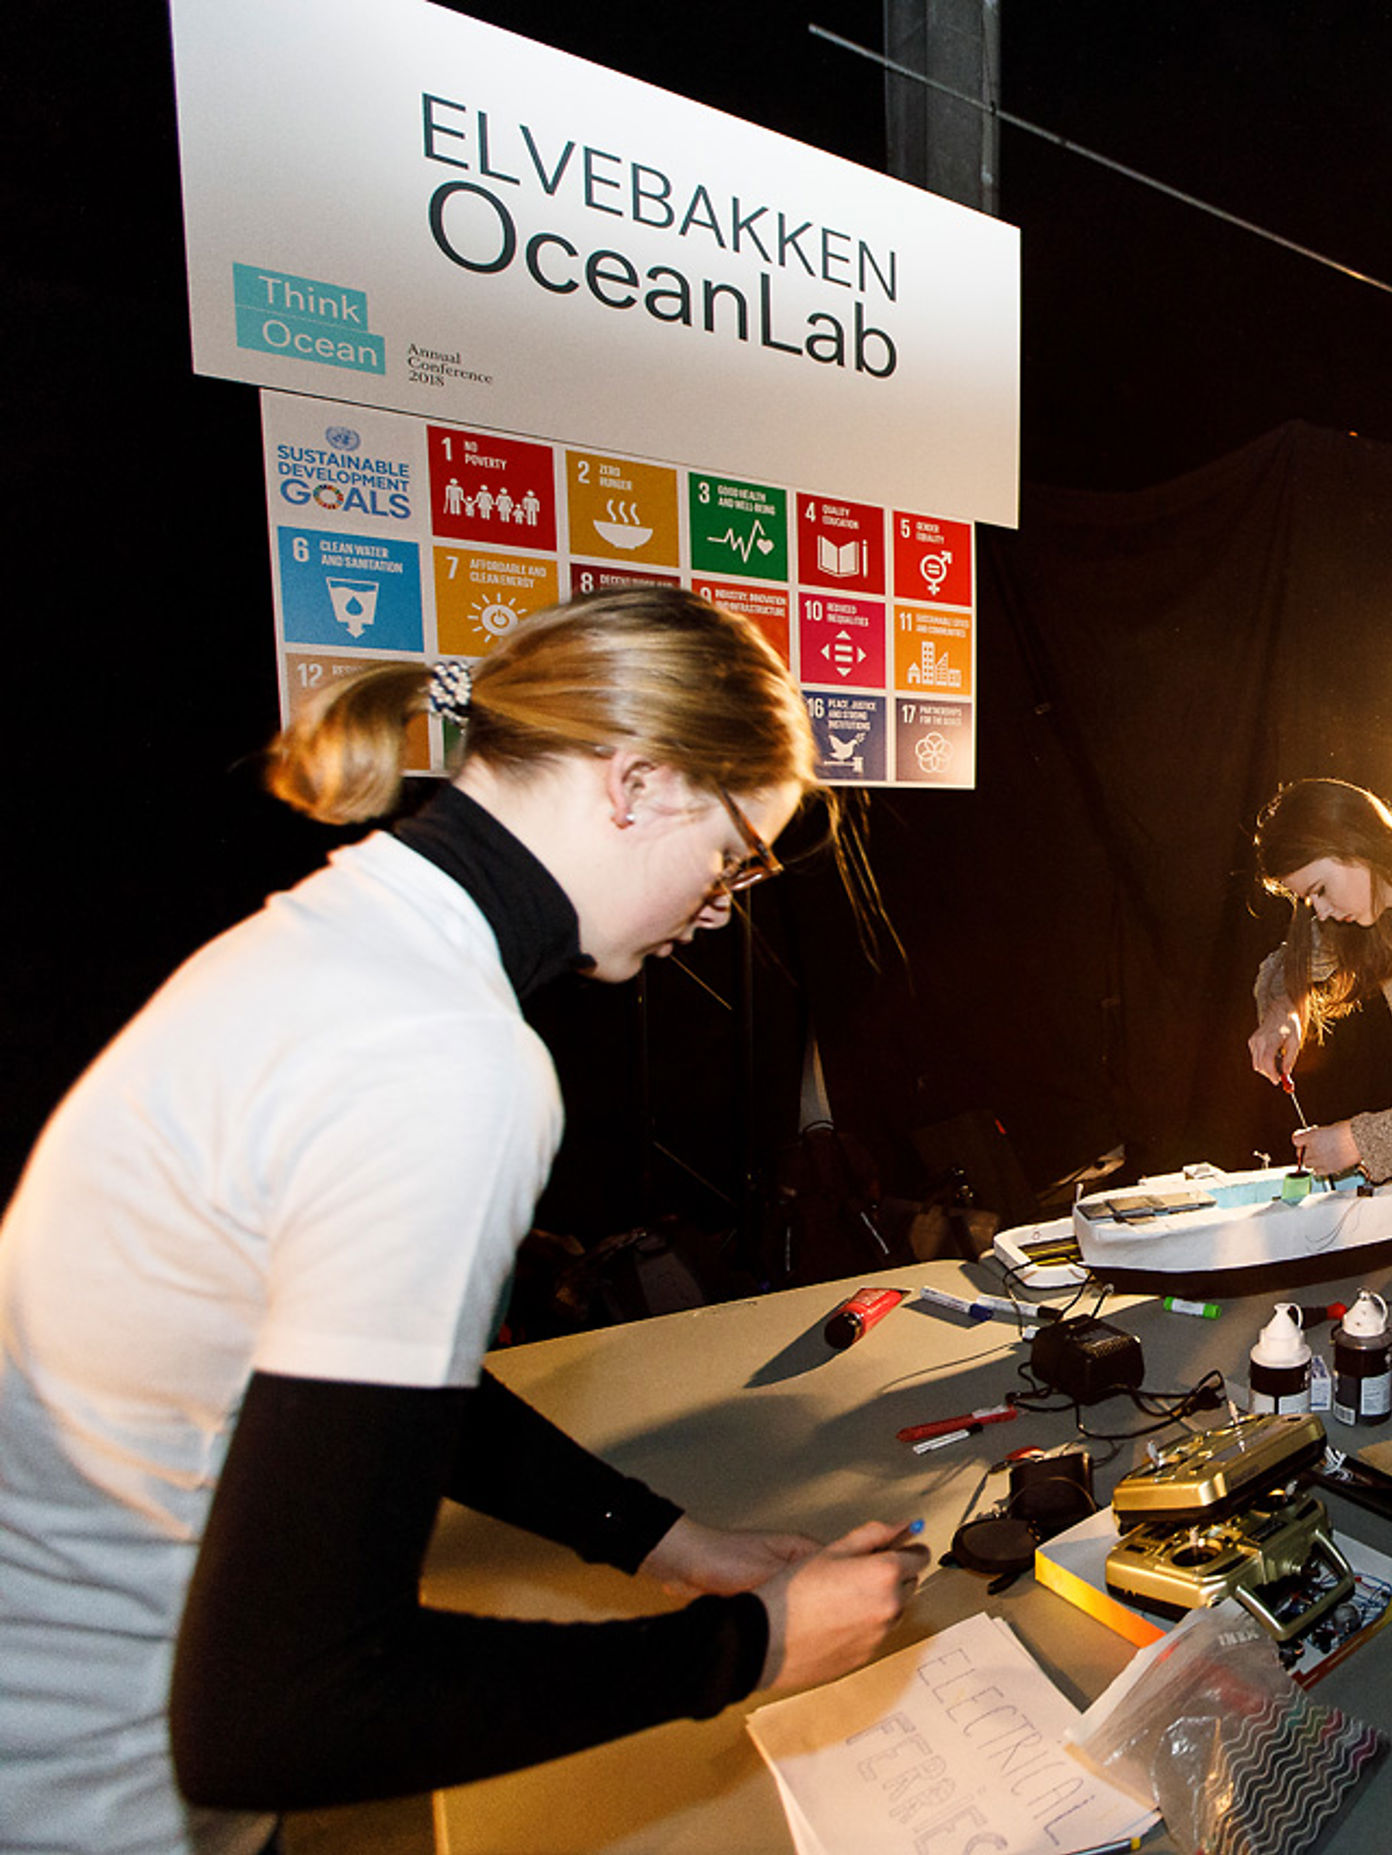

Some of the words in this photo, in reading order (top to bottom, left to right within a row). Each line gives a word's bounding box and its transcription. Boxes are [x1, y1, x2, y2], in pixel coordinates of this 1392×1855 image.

[421, 92, 897, 303] ELVEBAKKEN
[428, 180, 898, 379] OceanLab
[257, 275, 361, 324] Think
[262, 319, 377, 366] Ocean
[408, 343, 461, 365] Annual
[408, 356, 493, 385] Conference
[408, 370, 445, 387] 2018
[441, 437, 452, 461] 1
[278, 444, 409, 479] SUSTAINABLE
[464, 453, 507, 470] POVERTY
[577, 461, 590, 484] 2
[278, 461, 409, 492] DEVELOPMENT
[280, 478, 411, 519] GOALS
[699, 482, 710, 503] 3
[805, 501, 816, 522] 4
[901, 519, 910, 538] 5
[292, 537, 309, 562] 6
[320, 540, 353, 554] CLEAN
[354, 544, 389, 559] WATER
[321, 555, 343, 567] AND
[345, 557, 403, 573] SANITATION
[446, 556, 459, 579] 7
[580, 572, 594, 594] 8
[804, 600, 823, 621] 10
[900, 612, 912, 632] 11
[297, 663, 323, 687] 12
[807, 698, 825, 720] 16
[902, 705, 916, 724] 17
[917, 1648, 1095, 1847] ELECTRICAL
